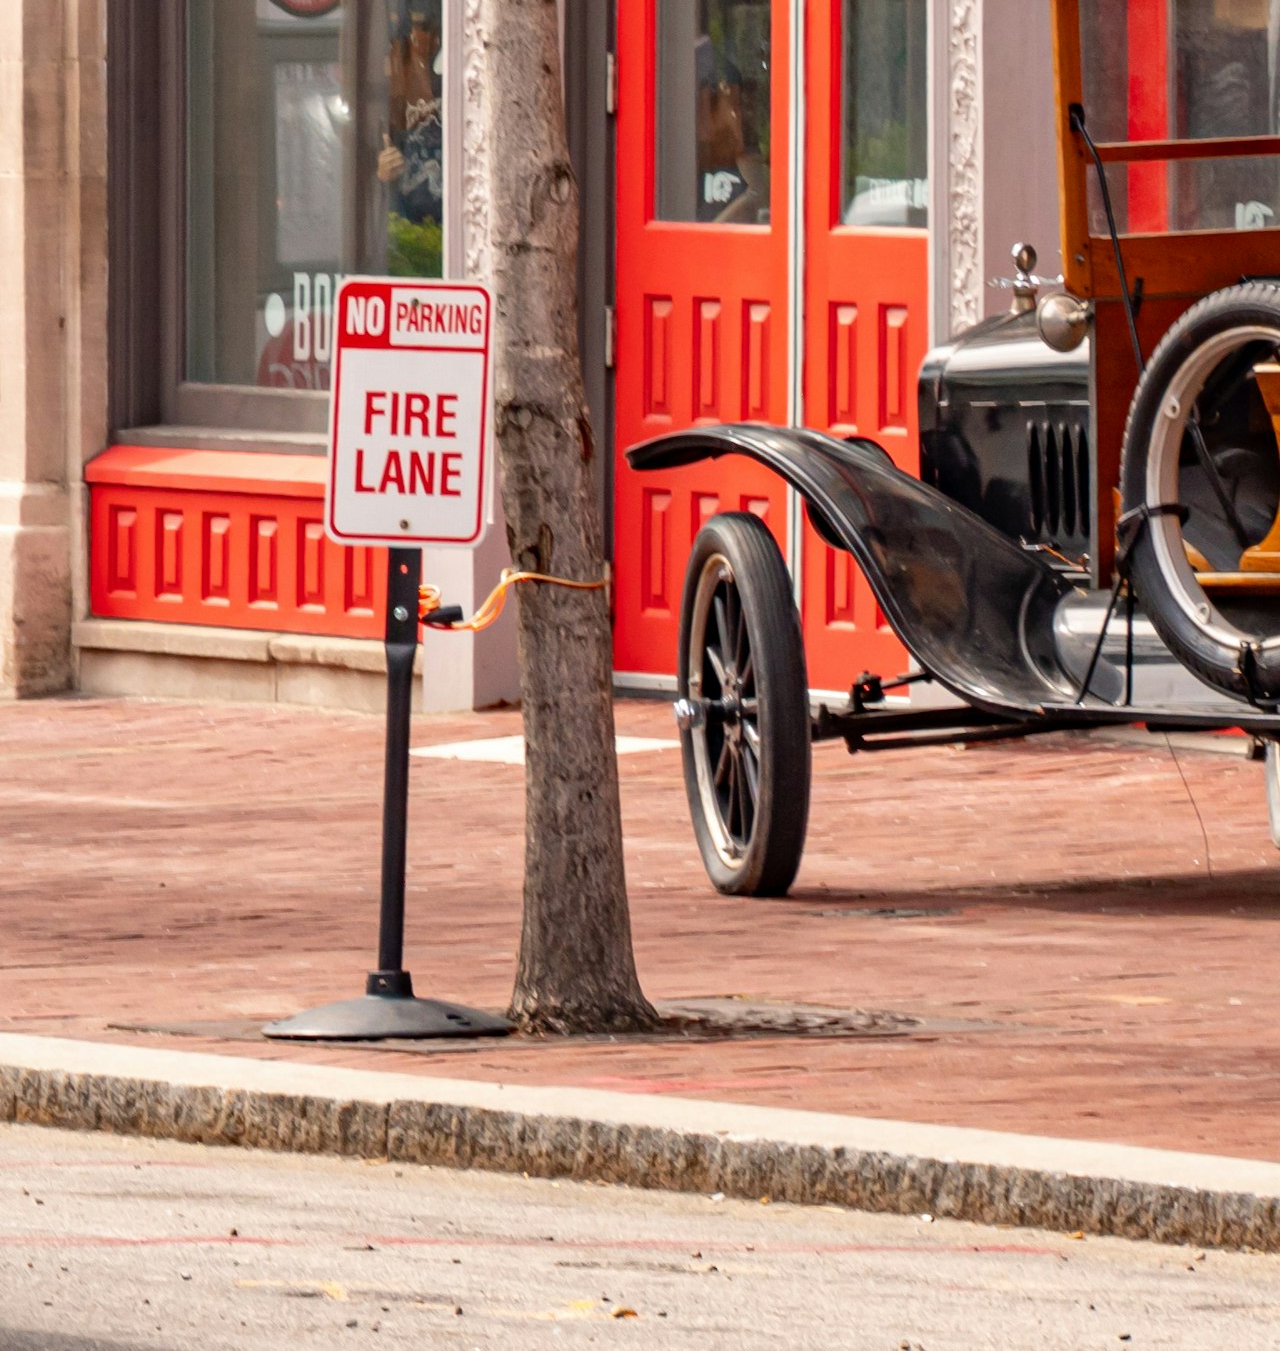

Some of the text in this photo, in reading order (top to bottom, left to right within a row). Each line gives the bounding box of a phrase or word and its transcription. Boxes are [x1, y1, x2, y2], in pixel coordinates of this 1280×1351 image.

[294, 271, 345, 362] BO
[346, 294, 483, 337] NO PARKING
[364, 390, 459, 438] FIRE
[355, 448, 463, 498] LANE
